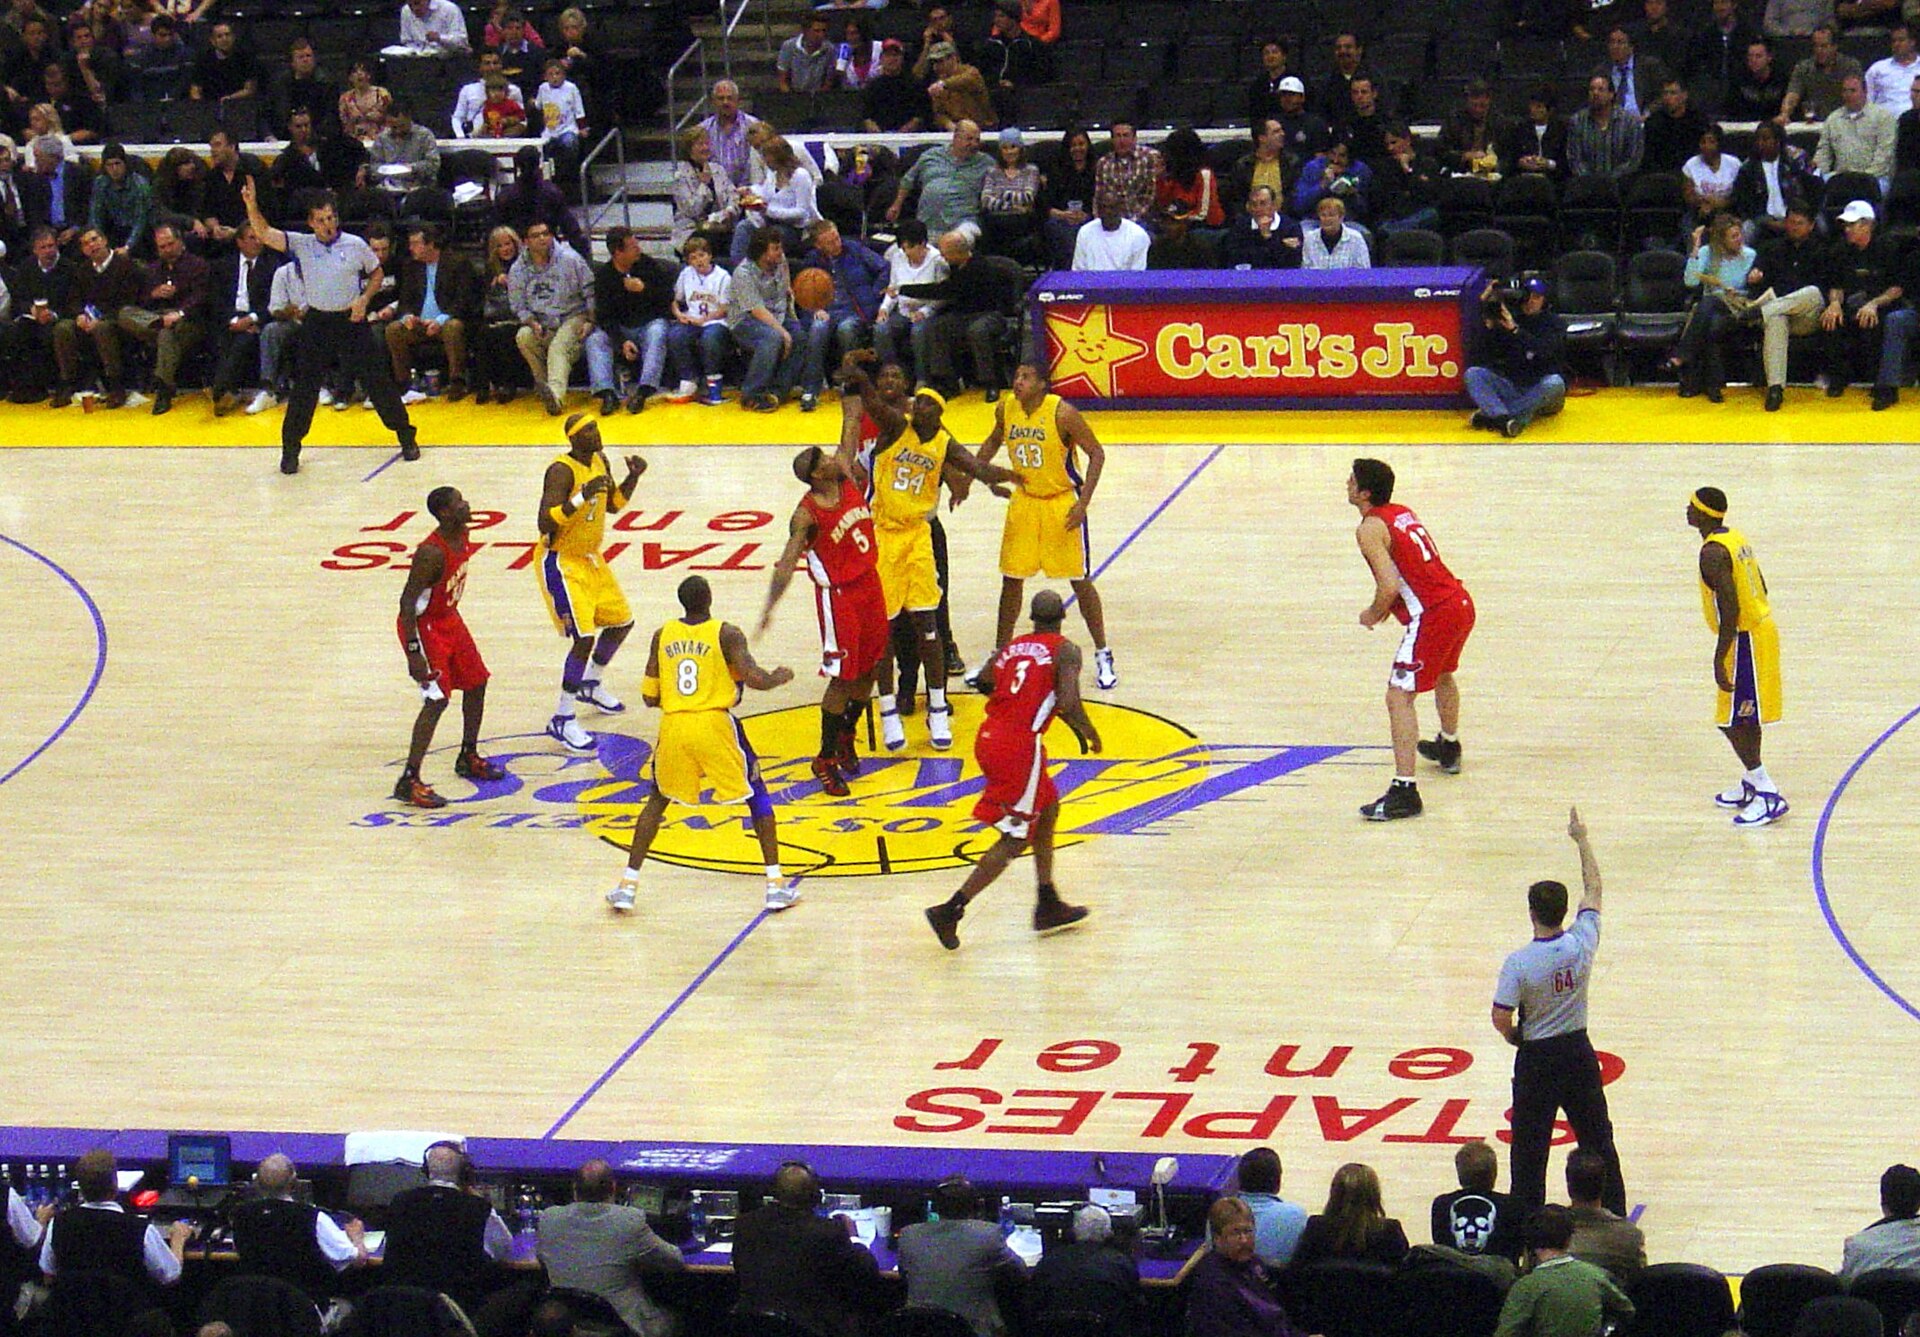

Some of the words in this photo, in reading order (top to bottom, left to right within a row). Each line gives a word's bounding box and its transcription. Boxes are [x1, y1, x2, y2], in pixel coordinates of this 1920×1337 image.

[1155, 322, 1356, 379] Carl's
[1361, 322, 1459, 378] Jr.
[1008, 424, 1046, 441] LAKERS
[1014, 443, 1044, 468] 43
[893, 465, 926, 495] 54
[852, 527, 870, 553] 5
[664, 640, 712, 658] BRYANT
[676, 657, 699, 696] 8
[1009, 659, 1031, 695] 3
[1554, 968, 1574, 993] 64
